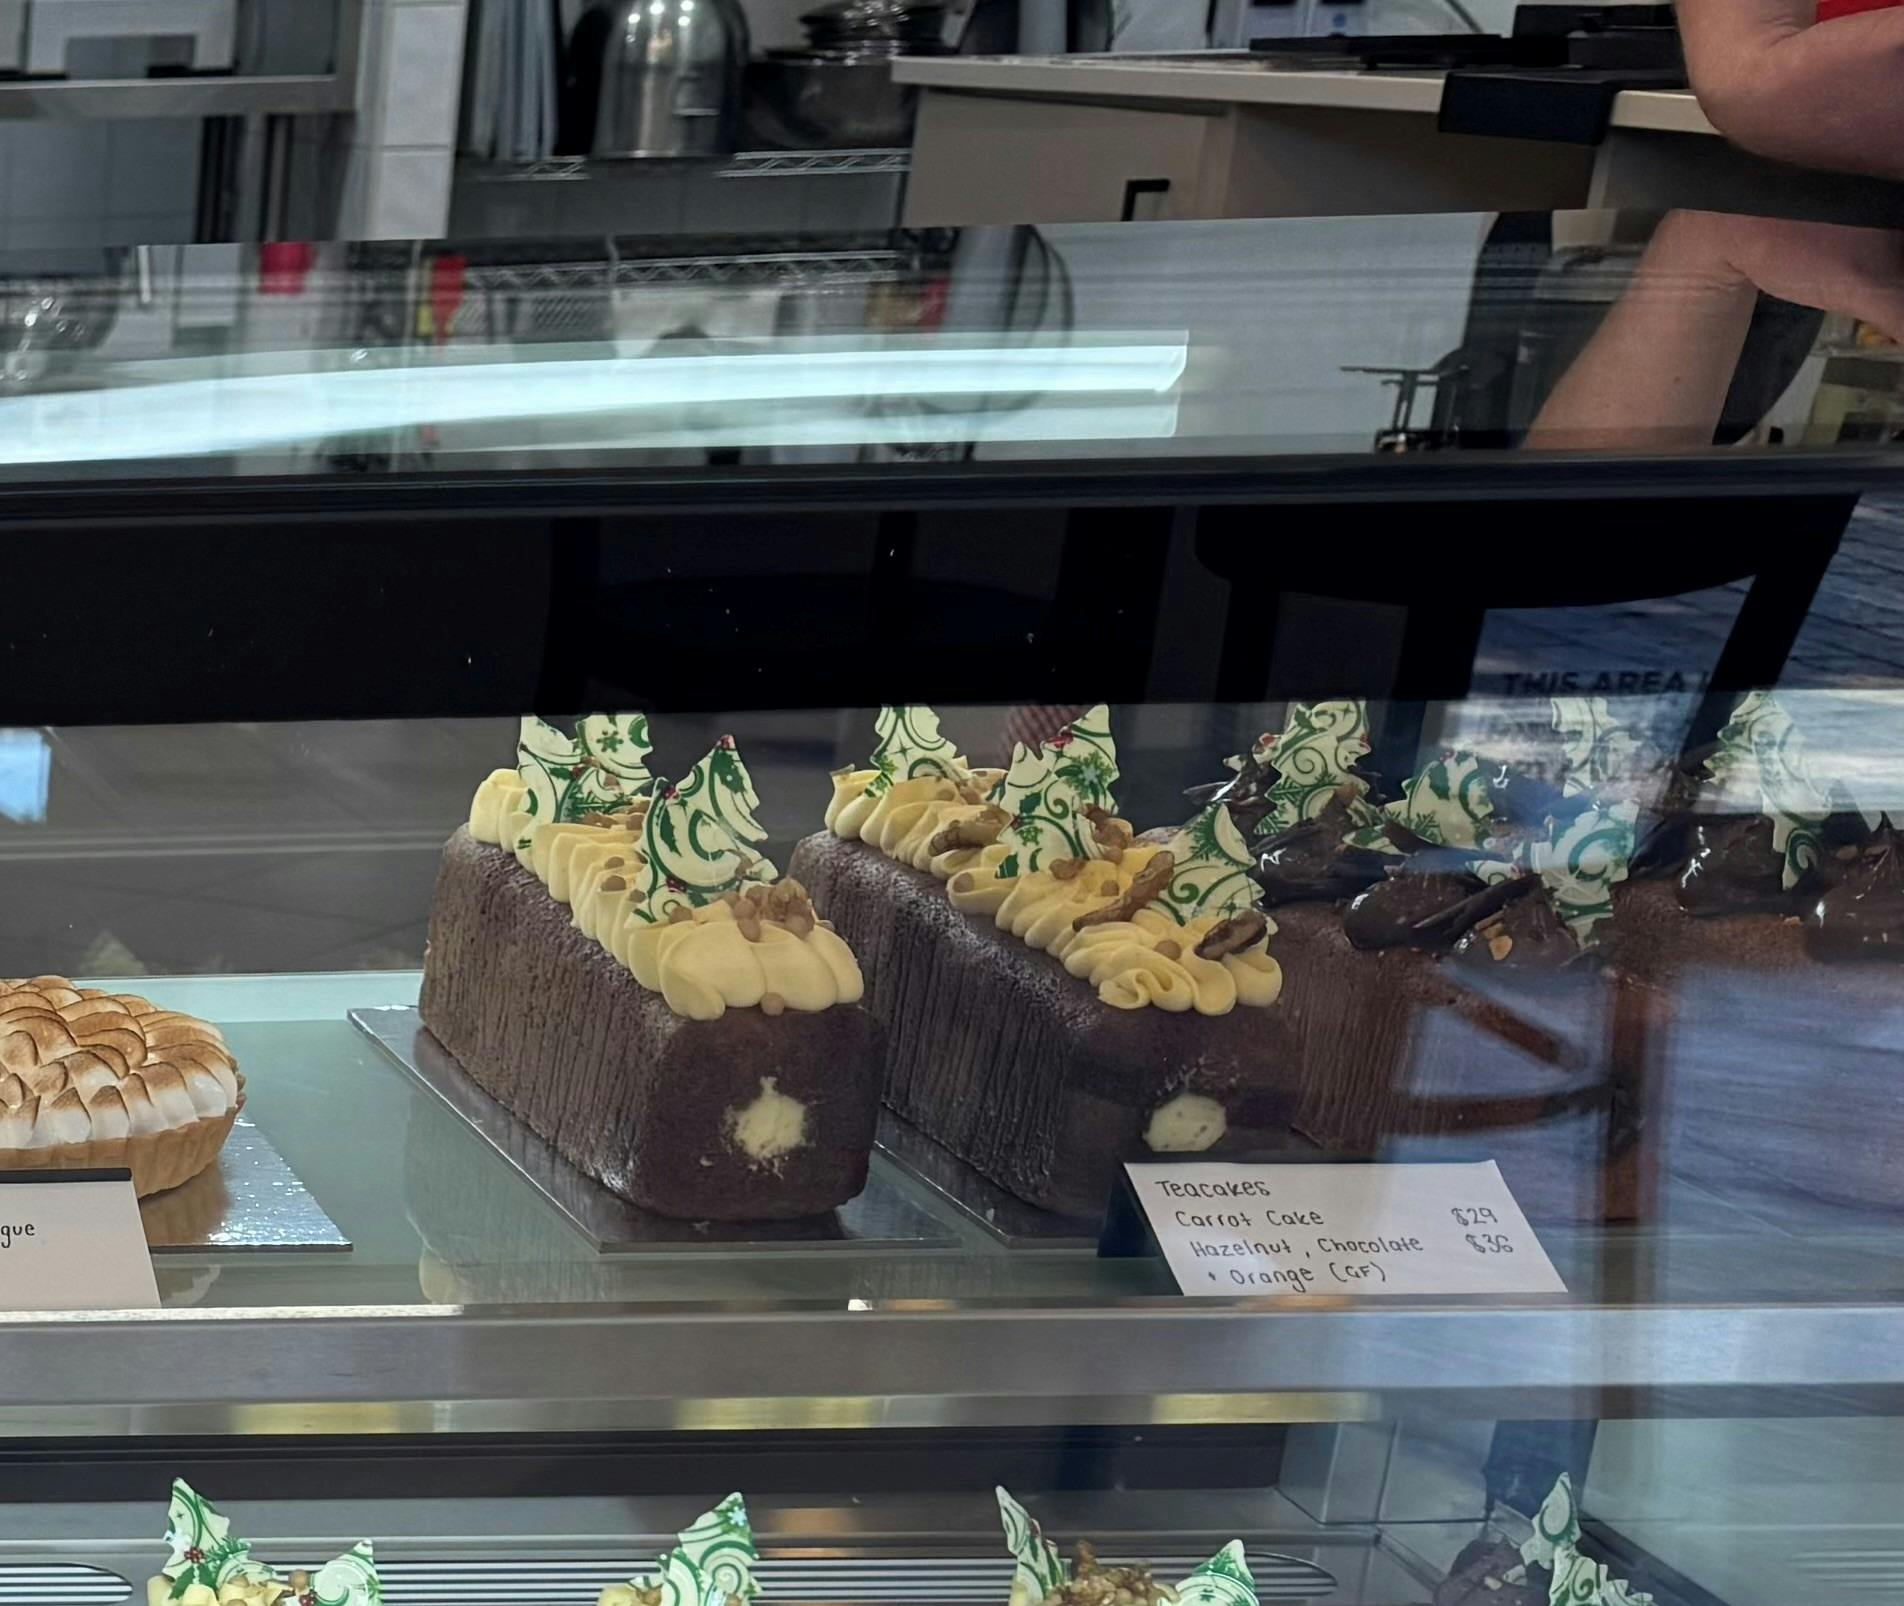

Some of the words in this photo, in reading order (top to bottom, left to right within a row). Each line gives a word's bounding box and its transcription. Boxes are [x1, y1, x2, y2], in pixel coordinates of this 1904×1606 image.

[1501, 670, 1581, 695] THIS
[1590, 669, 1688, 694] AREA
[1155, 1179, 1271, 1199] Teacakes
[1175, 1210, 1252, 1228] Carrot
[1266, 1210, 1325, 1226] Cake
[1450, 1206, 1499, 1226] $29
[1317, 1236, 1424, 1254] Chocolate
[1230, 1266, 1315, 1293] Orange
[1329, 1260, 1387, 1282] (GF)
